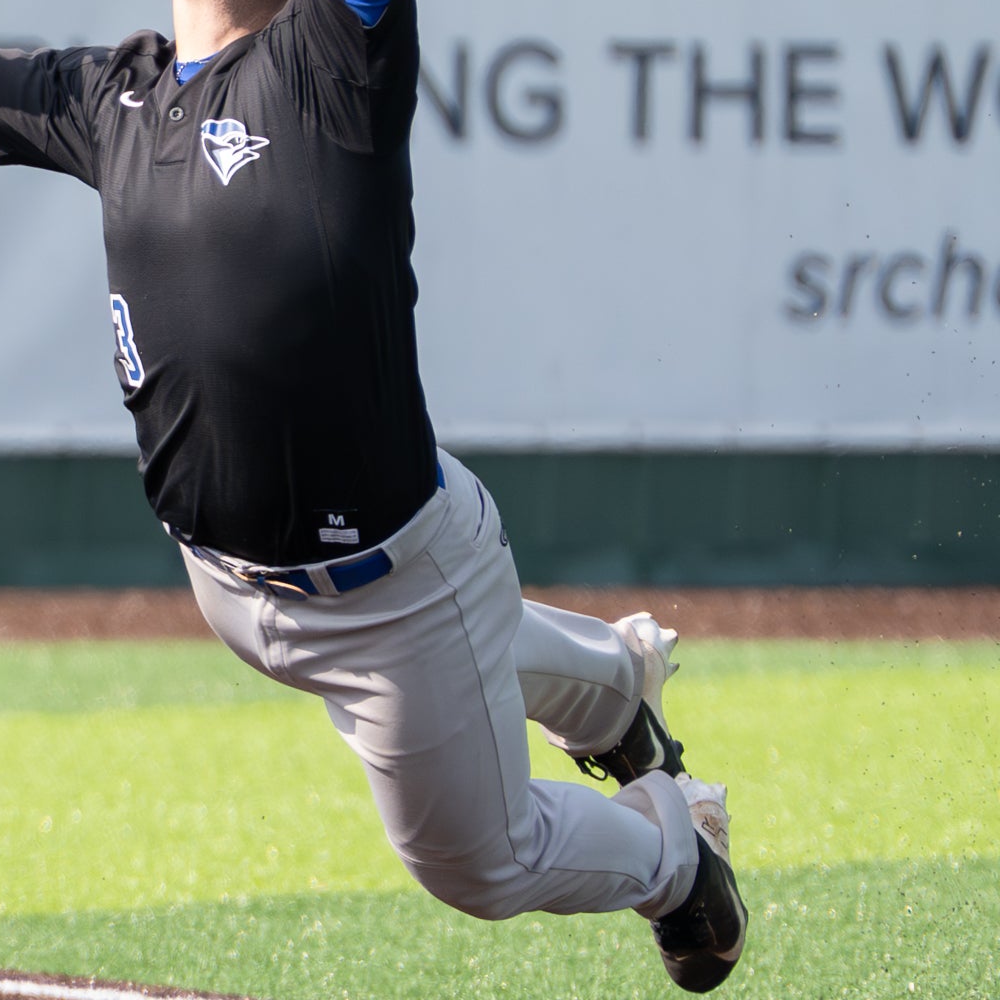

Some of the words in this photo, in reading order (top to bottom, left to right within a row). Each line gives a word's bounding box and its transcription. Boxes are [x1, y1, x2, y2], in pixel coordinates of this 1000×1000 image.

[611, 39, 842, 144] THE
[883, 40, 1000, 146] W
[785, 228, 1000, 324] srch
[328, 513, 345, 526] M
